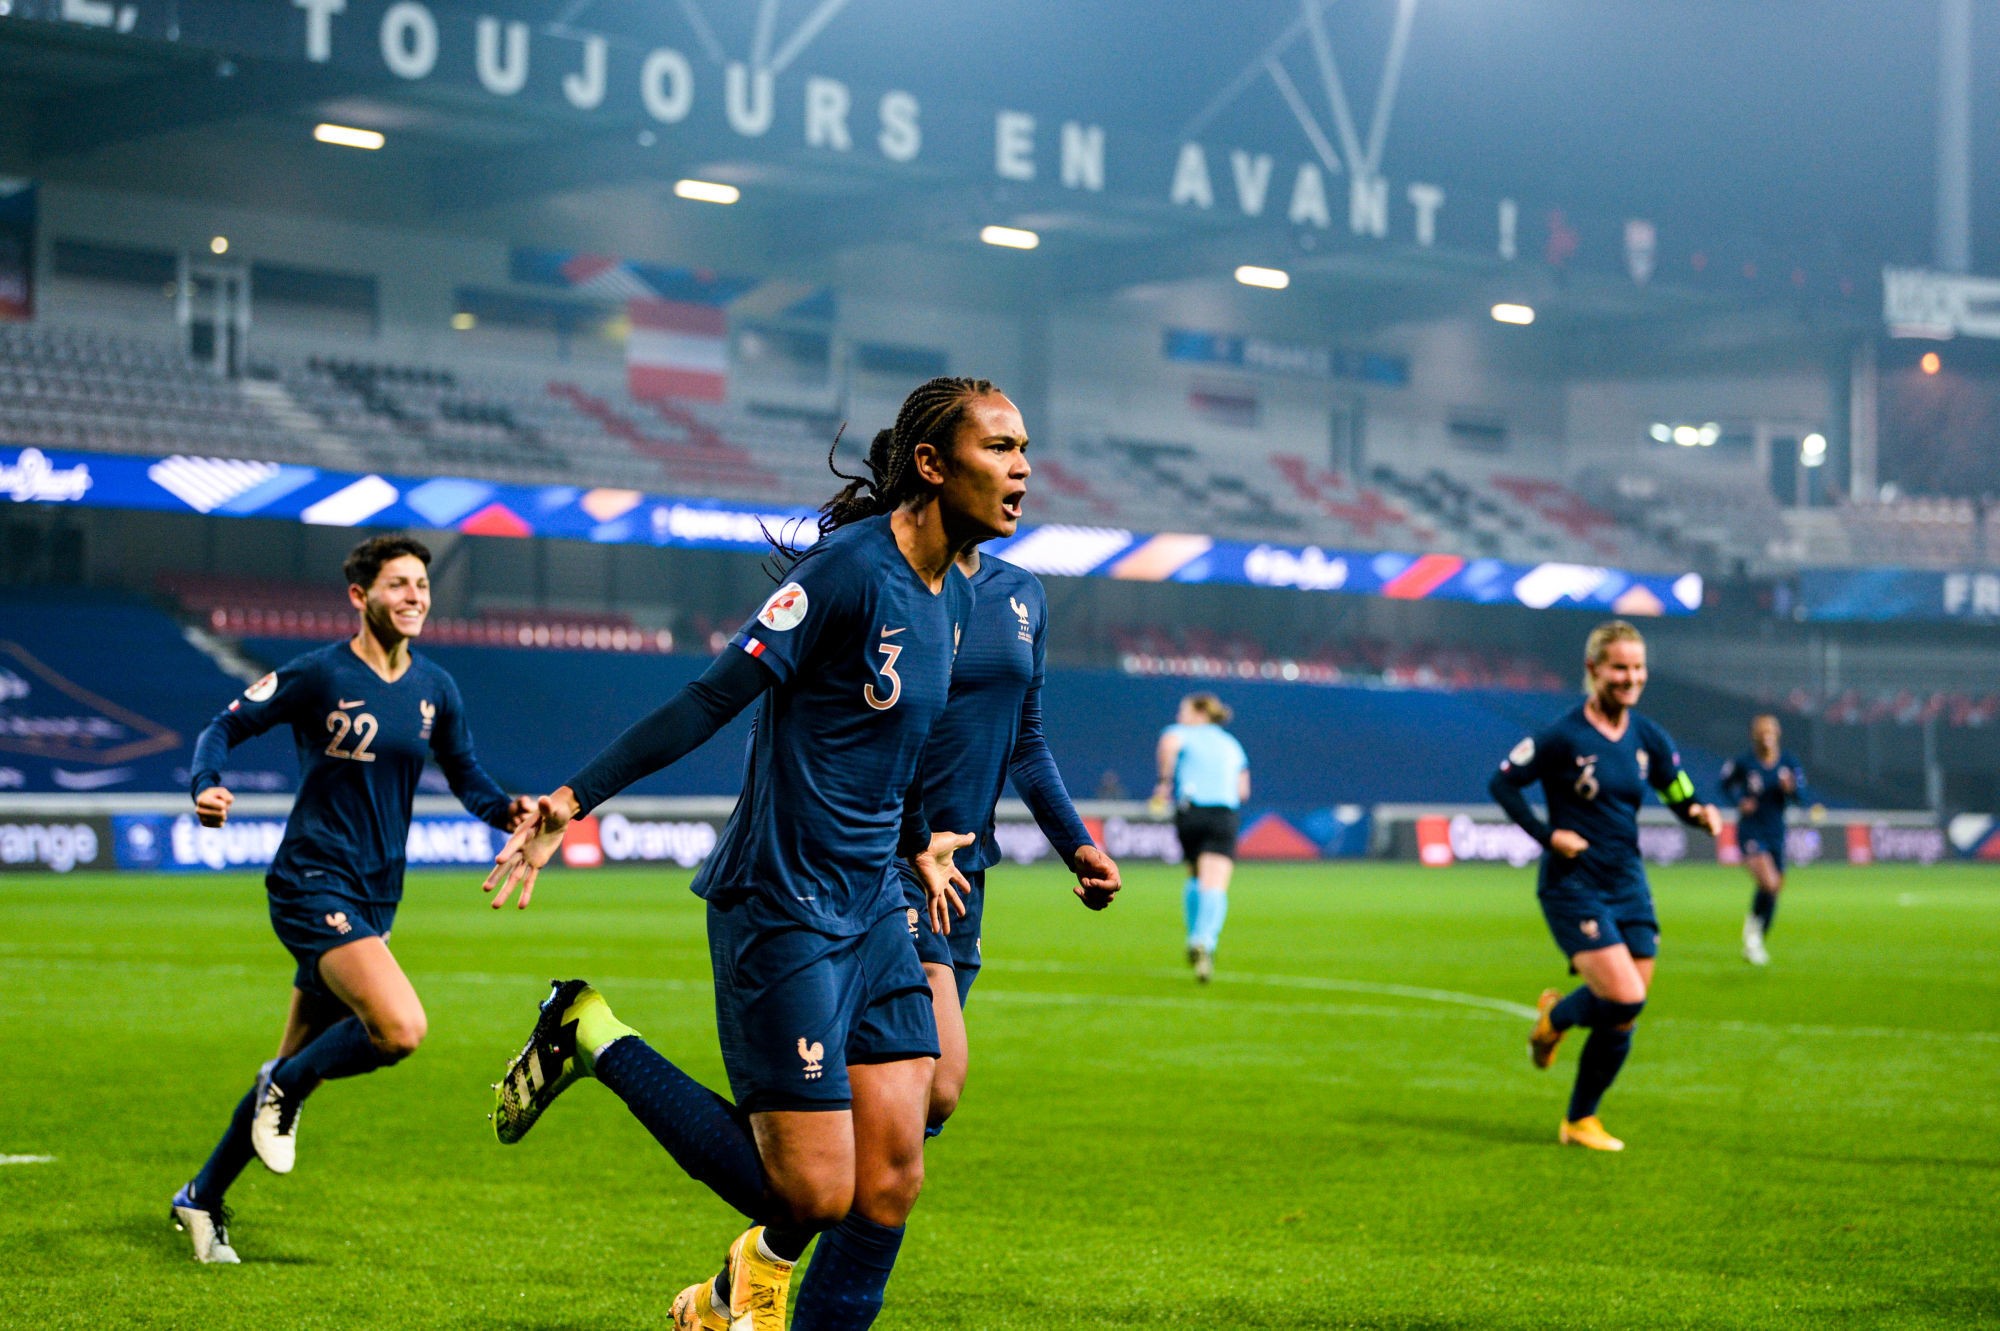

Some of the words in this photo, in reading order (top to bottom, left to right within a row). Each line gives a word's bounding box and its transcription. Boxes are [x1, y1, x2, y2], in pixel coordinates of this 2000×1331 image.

[292, 0, 921, 161] TOUJOURS
[995, 110, 1105, 192] EN
[1170, 141, 1446, 248] AVANT
[864, 643, 903, 710] 3
[325, 710, 379, 762] 22
[1575, 764, 1599, 800] 6
[0, 822, 99, 872] ange
[601, 812, 718, 868] Orange
